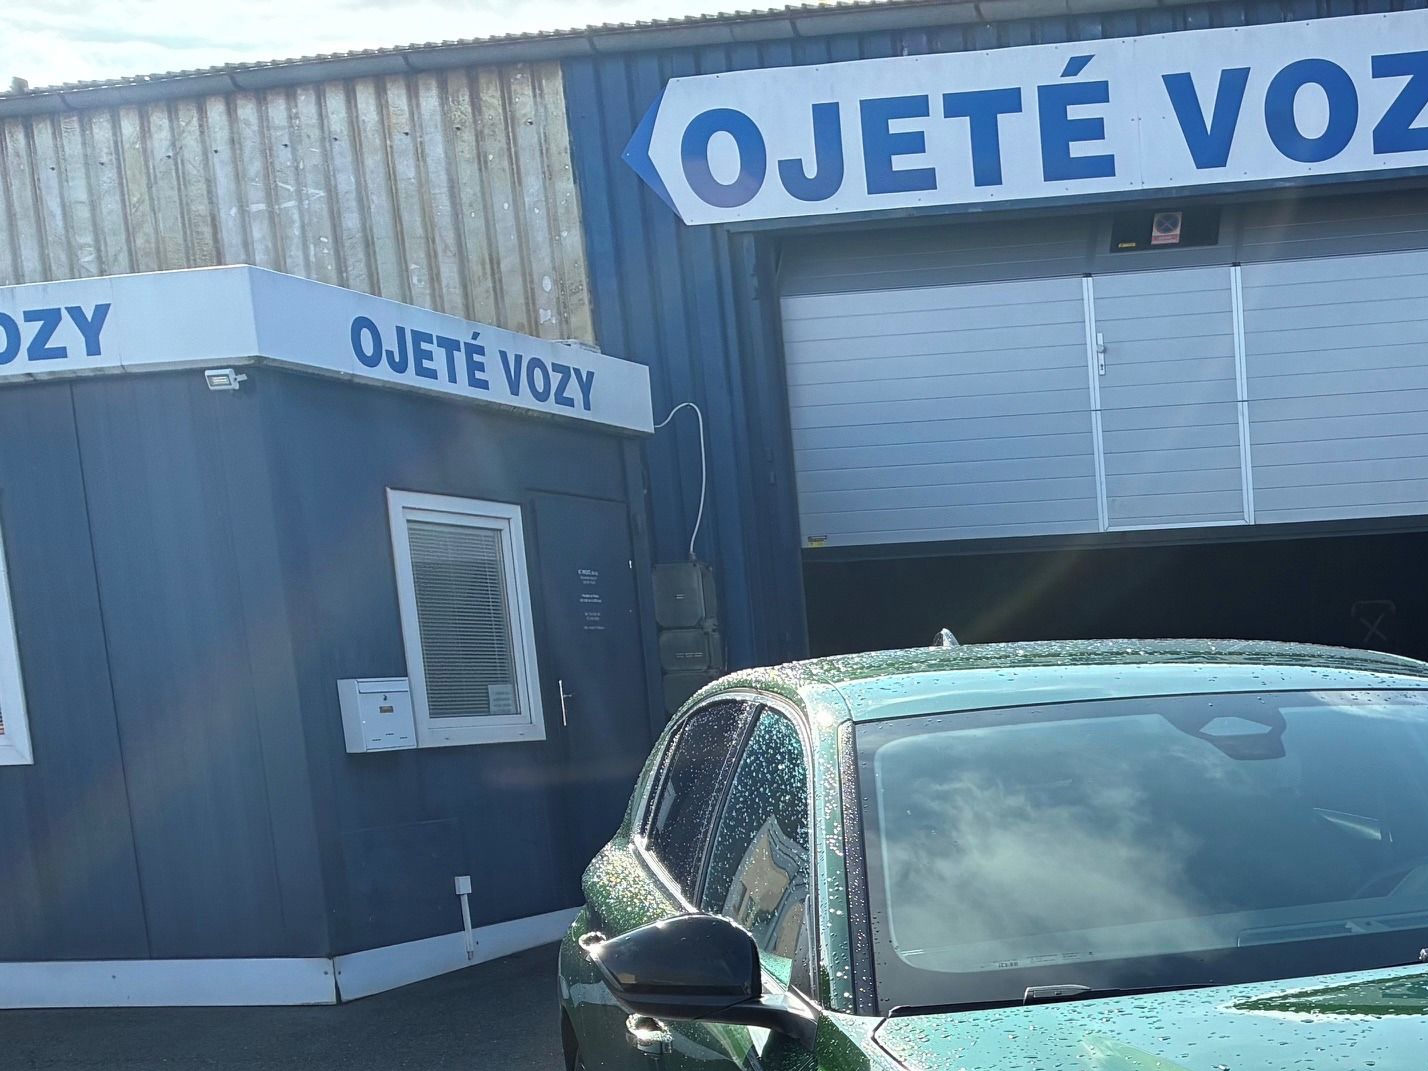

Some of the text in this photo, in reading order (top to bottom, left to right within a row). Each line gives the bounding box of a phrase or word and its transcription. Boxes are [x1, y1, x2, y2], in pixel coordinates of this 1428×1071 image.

[680, 55, 1117, 209] OJETÉ
[350, 316, 595, 412] OJETÉ VOZY
